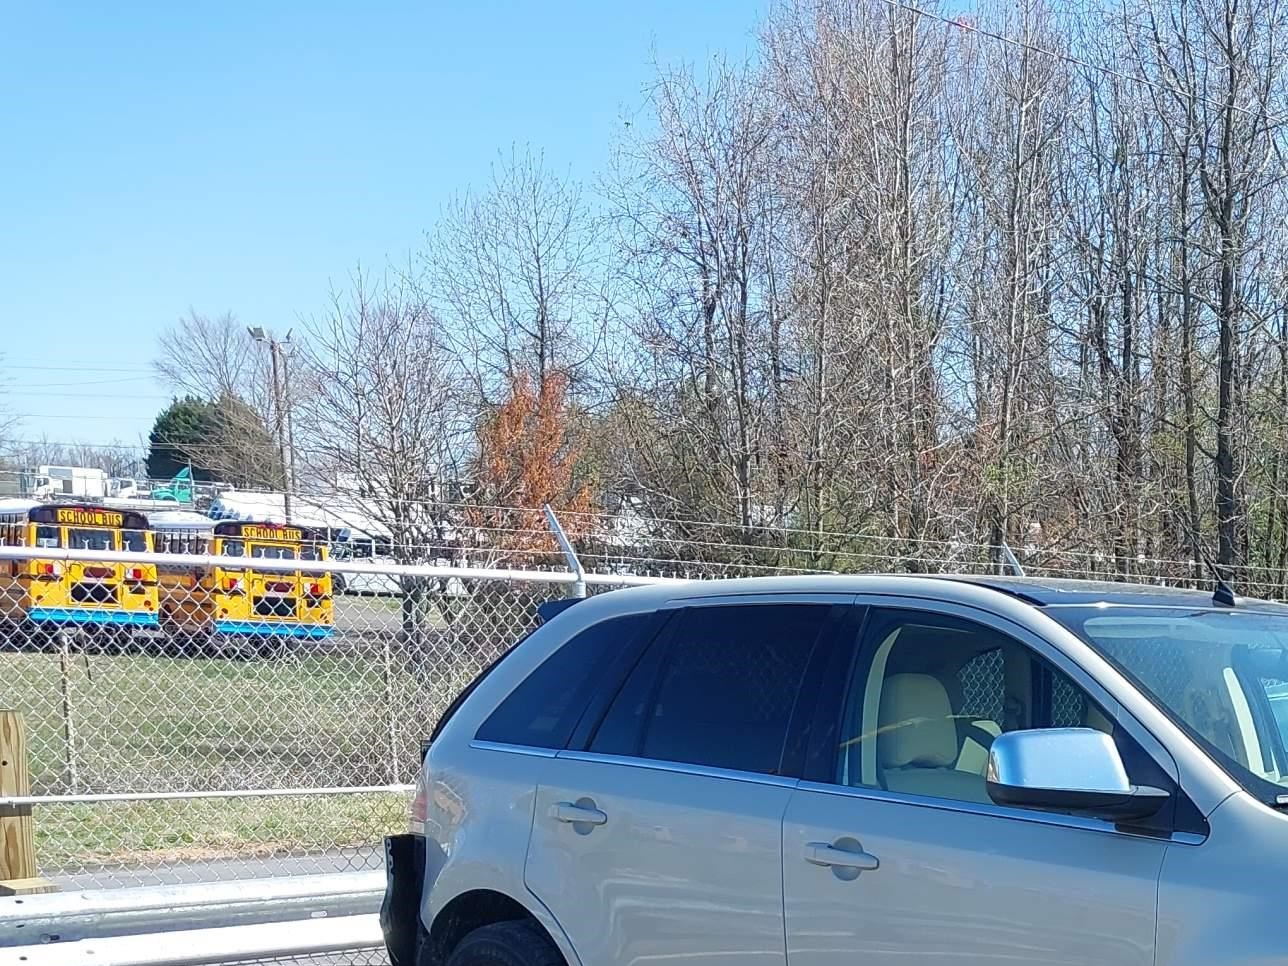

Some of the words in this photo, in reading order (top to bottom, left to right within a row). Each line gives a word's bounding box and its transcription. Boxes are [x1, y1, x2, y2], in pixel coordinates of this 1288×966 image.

[59, 510, 99, 525] SCHOOL
[102, 513, 122, 527] BUS
[243, 526, 280, 540] SCHOOL
[282, 530, 301, 541] BUS
